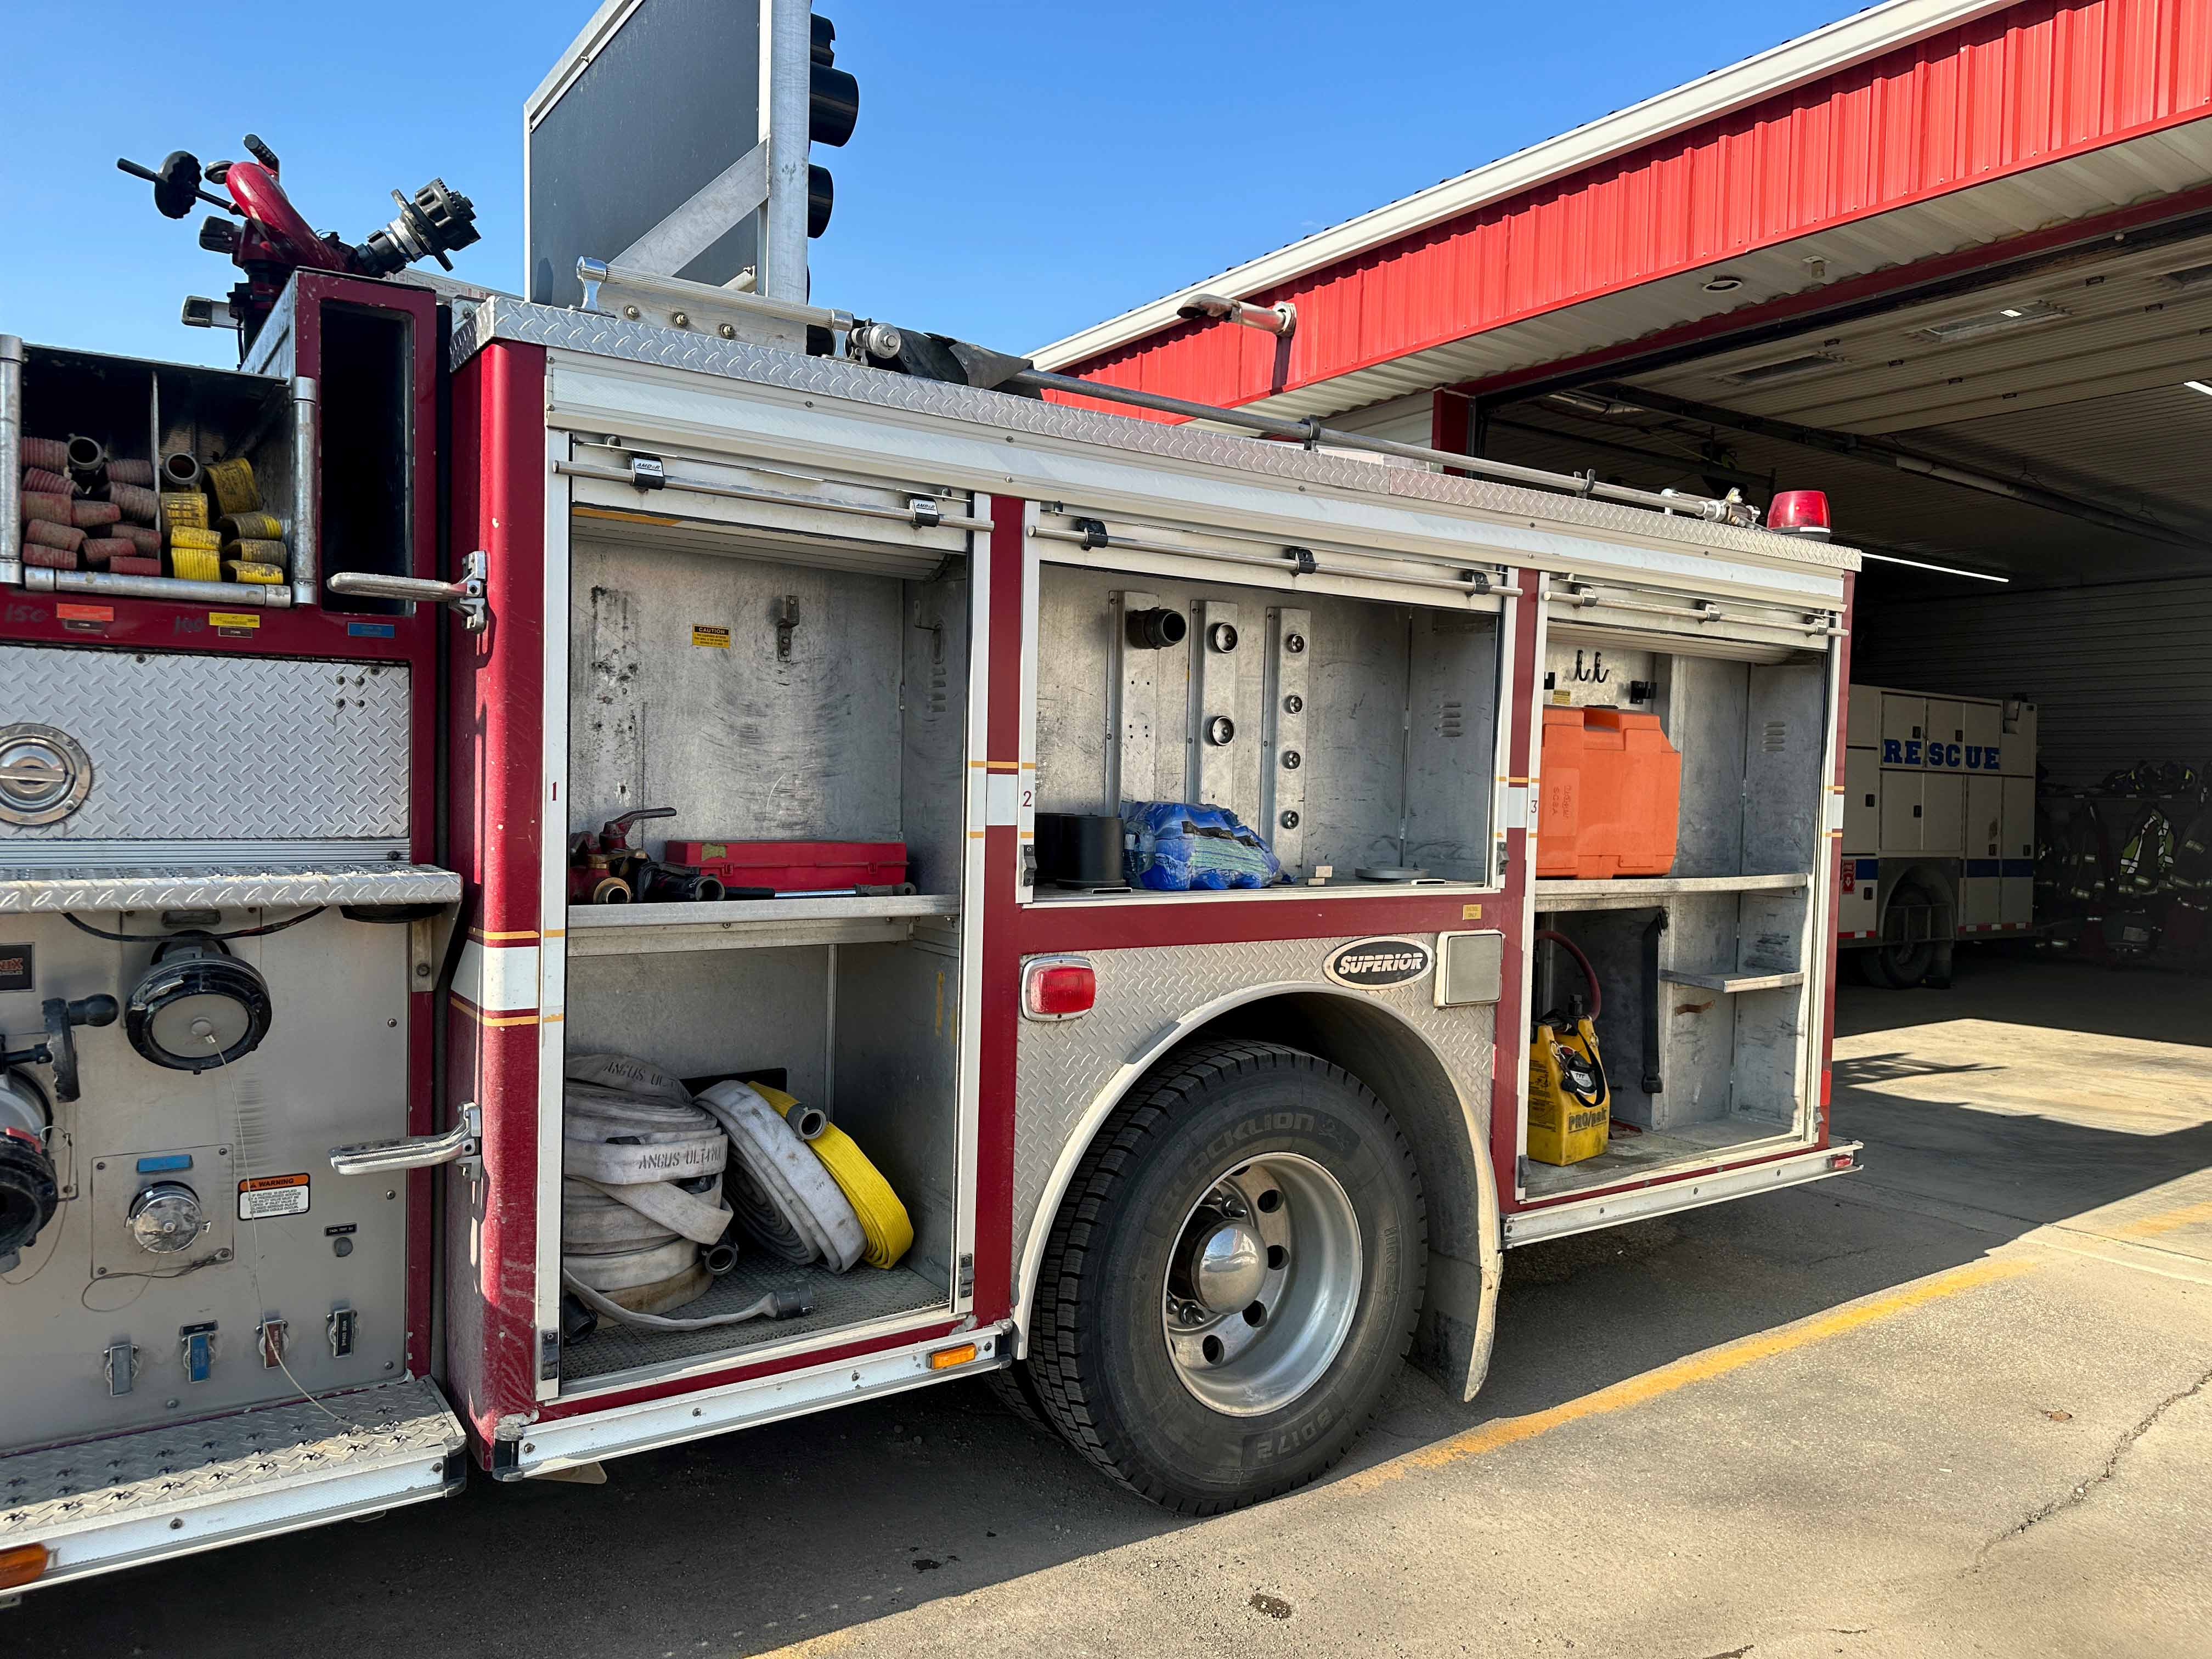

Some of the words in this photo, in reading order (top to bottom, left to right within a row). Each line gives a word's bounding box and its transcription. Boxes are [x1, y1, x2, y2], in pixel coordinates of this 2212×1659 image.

[1883, 738, 2000, 770] RESCUE
[552, 781, 557, 801] 1
[1023, 791, 1031, 807] 2
[1531, 800, 1537, 813] 3
[1338, 952, 1424, 975] SUPERIOR
[603, 1062, 646, 1081] ANGUS
[639, 1152, 680, 1169] ANGUS
[258, 1178, 294, 1187] WARNING
